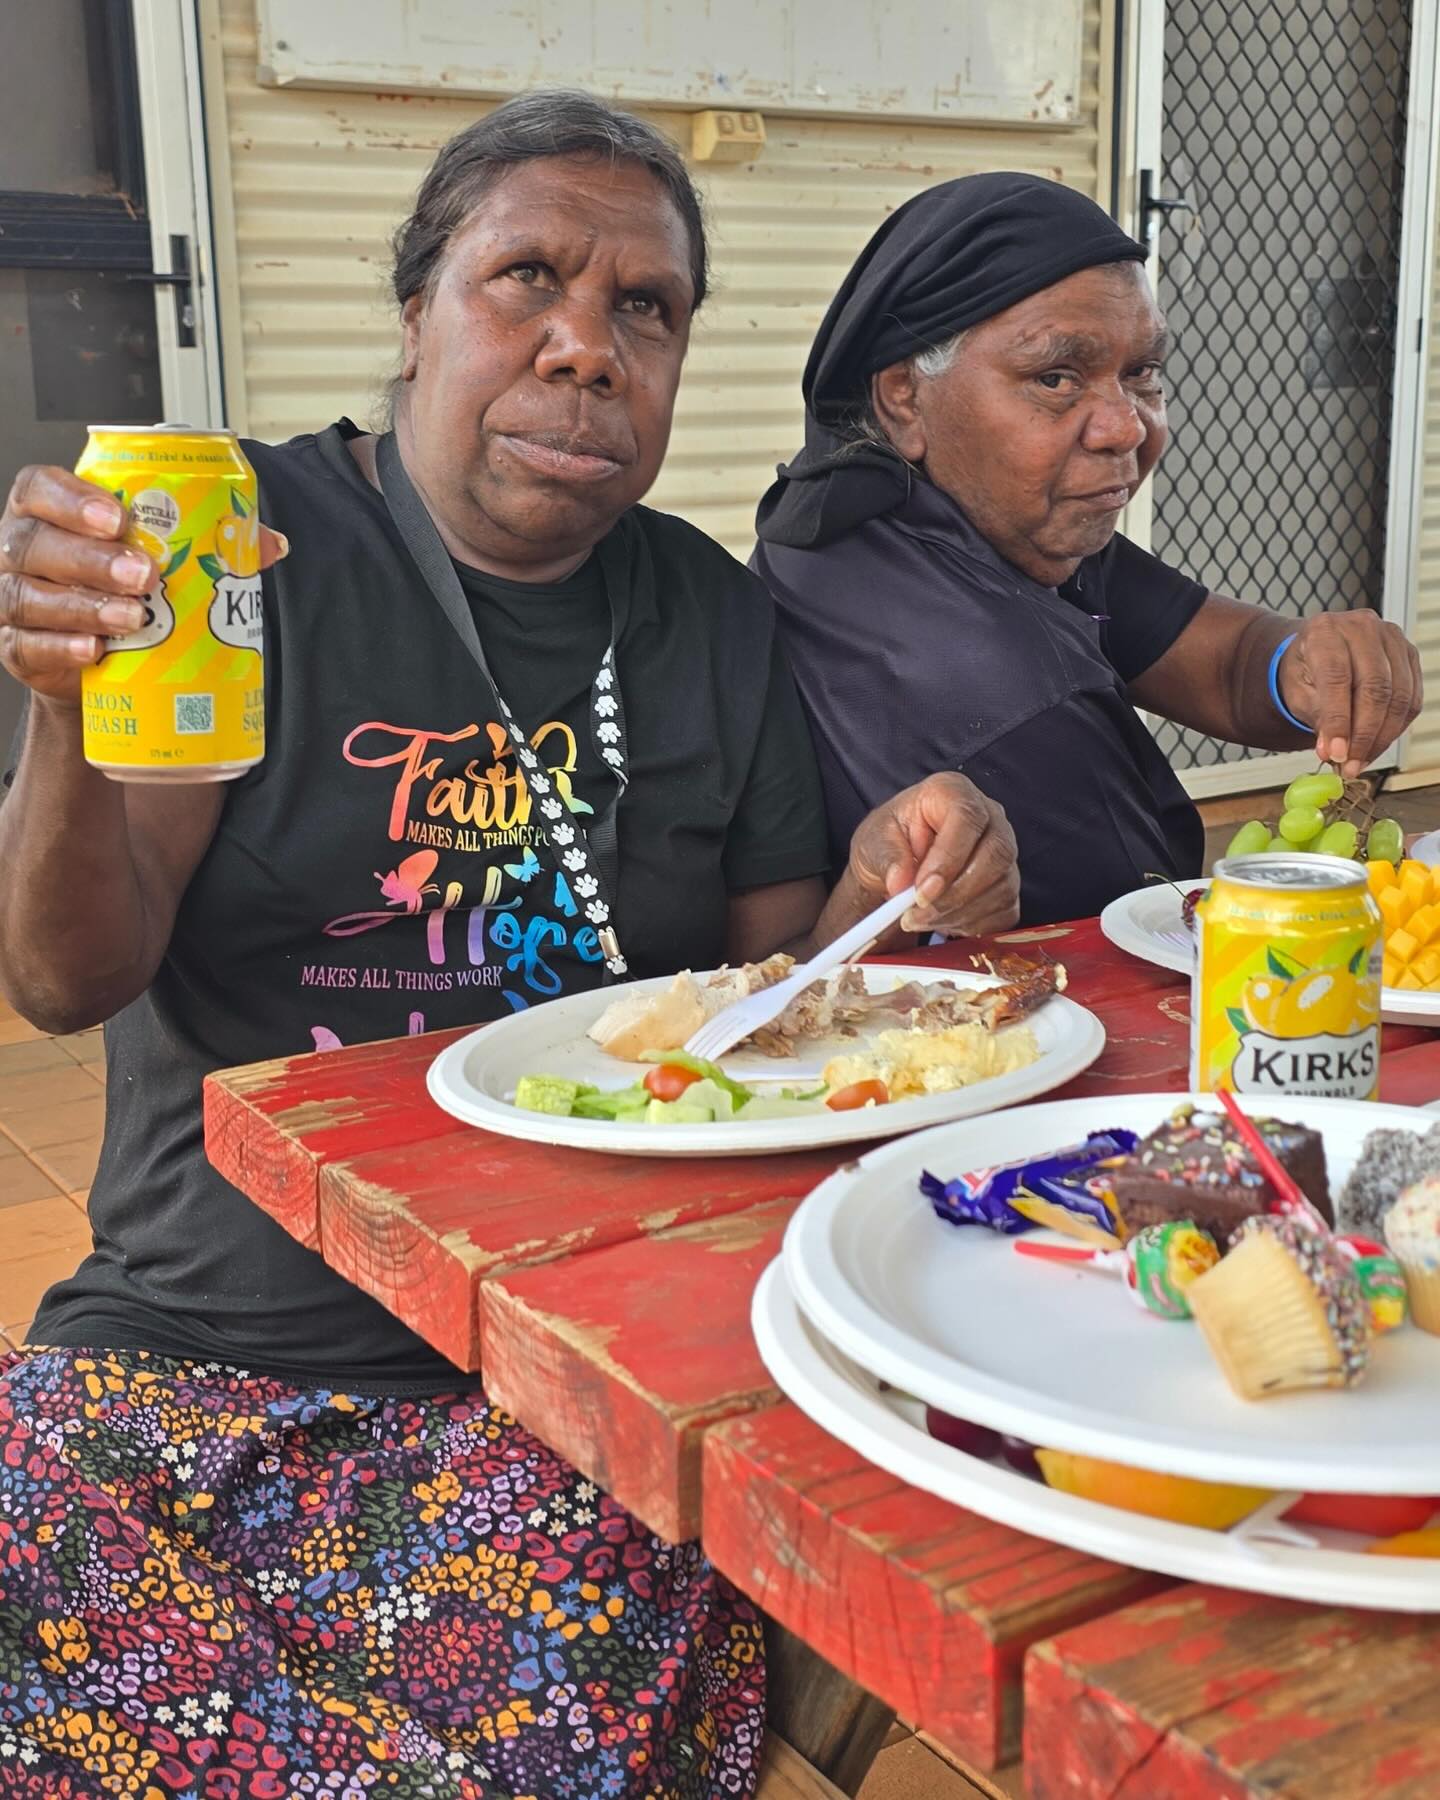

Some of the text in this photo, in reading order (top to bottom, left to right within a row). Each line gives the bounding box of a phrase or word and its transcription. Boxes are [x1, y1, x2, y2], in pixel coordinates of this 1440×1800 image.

[225, 590, 263, 626] KIR
[84, 690, 133, 713] EMON
[406, 820, 453, 848] MAKES
[455, 829, 481, 852] ALL
[483, 826, 534, 849] THINGS
[301, 965, 503, 991] MAKES ALL THINGS WORK
[1252, 1041, 1374, 1086] KIRKS
